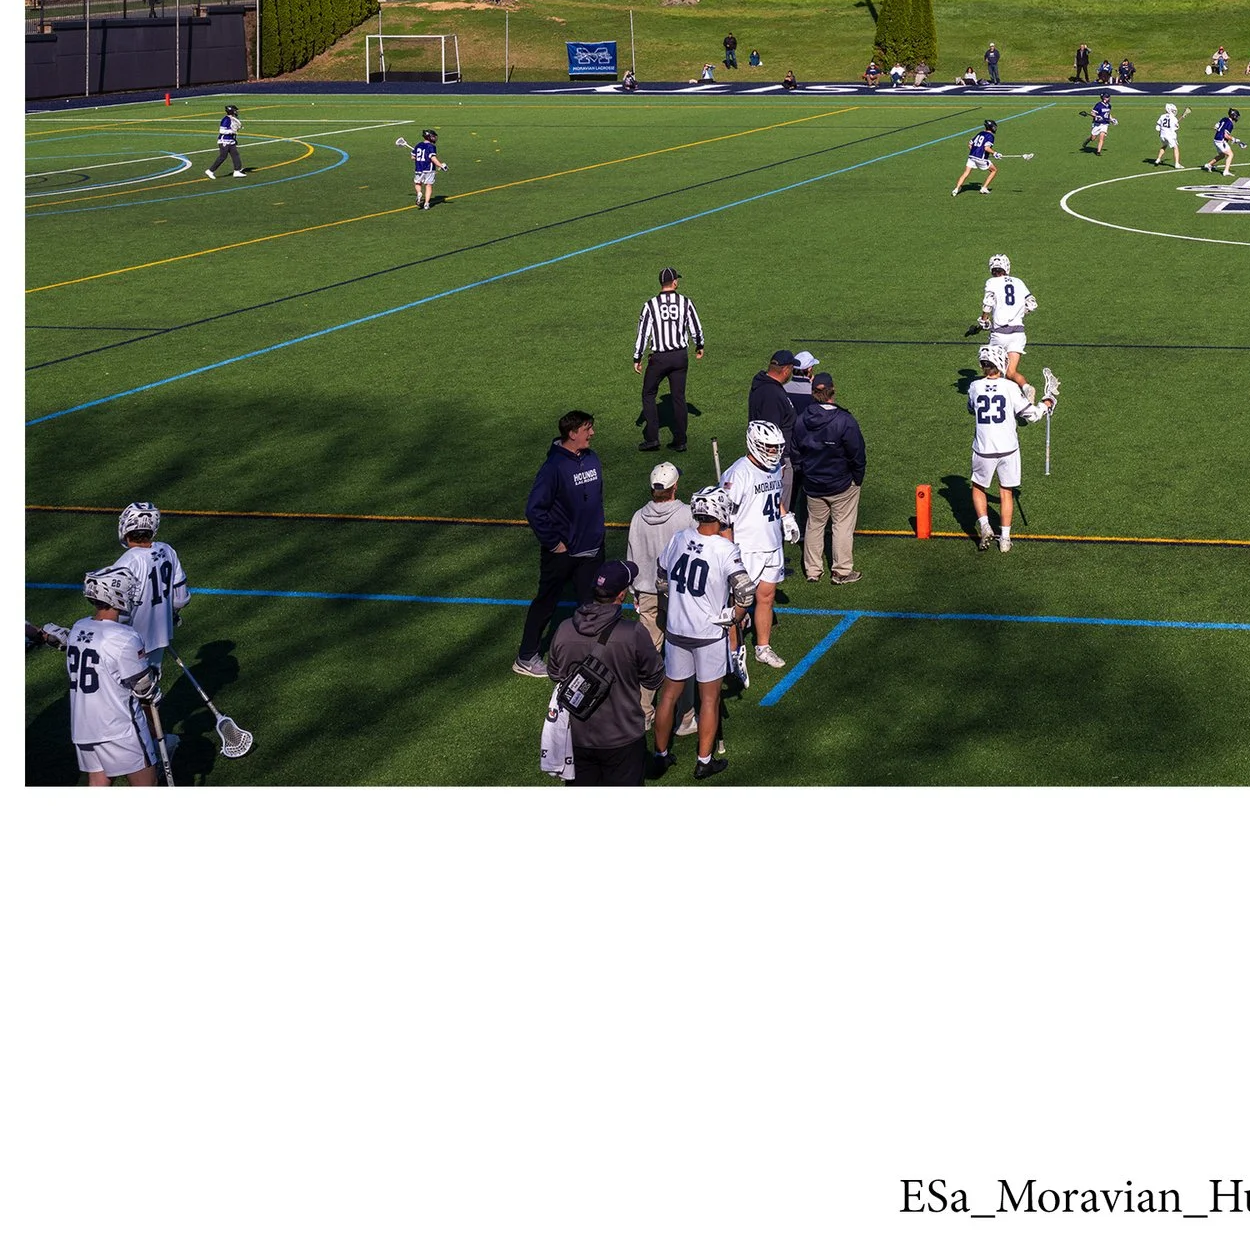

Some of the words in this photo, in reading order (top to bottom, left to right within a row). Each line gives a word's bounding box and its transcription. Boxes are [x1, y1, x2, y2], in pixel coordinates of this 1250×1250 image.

[1163, 118, 1171, 128] 21
[974, 135, 985, 147] 49
[416, 148, 426, 161] 21
[1004, 284, 1015, 306] 8
[660, 304, 679, 320] 89
[976, 394, 1006, 424] 23
[573, 468, 598, 483] HOUNDS
[762, 491, 781, 522] 49
[111, 578, 122, 588] 26
[148, 560, 173, 607] 19
[670, 552, 710, 598] 40
[67, 645, 100, 694] 26
